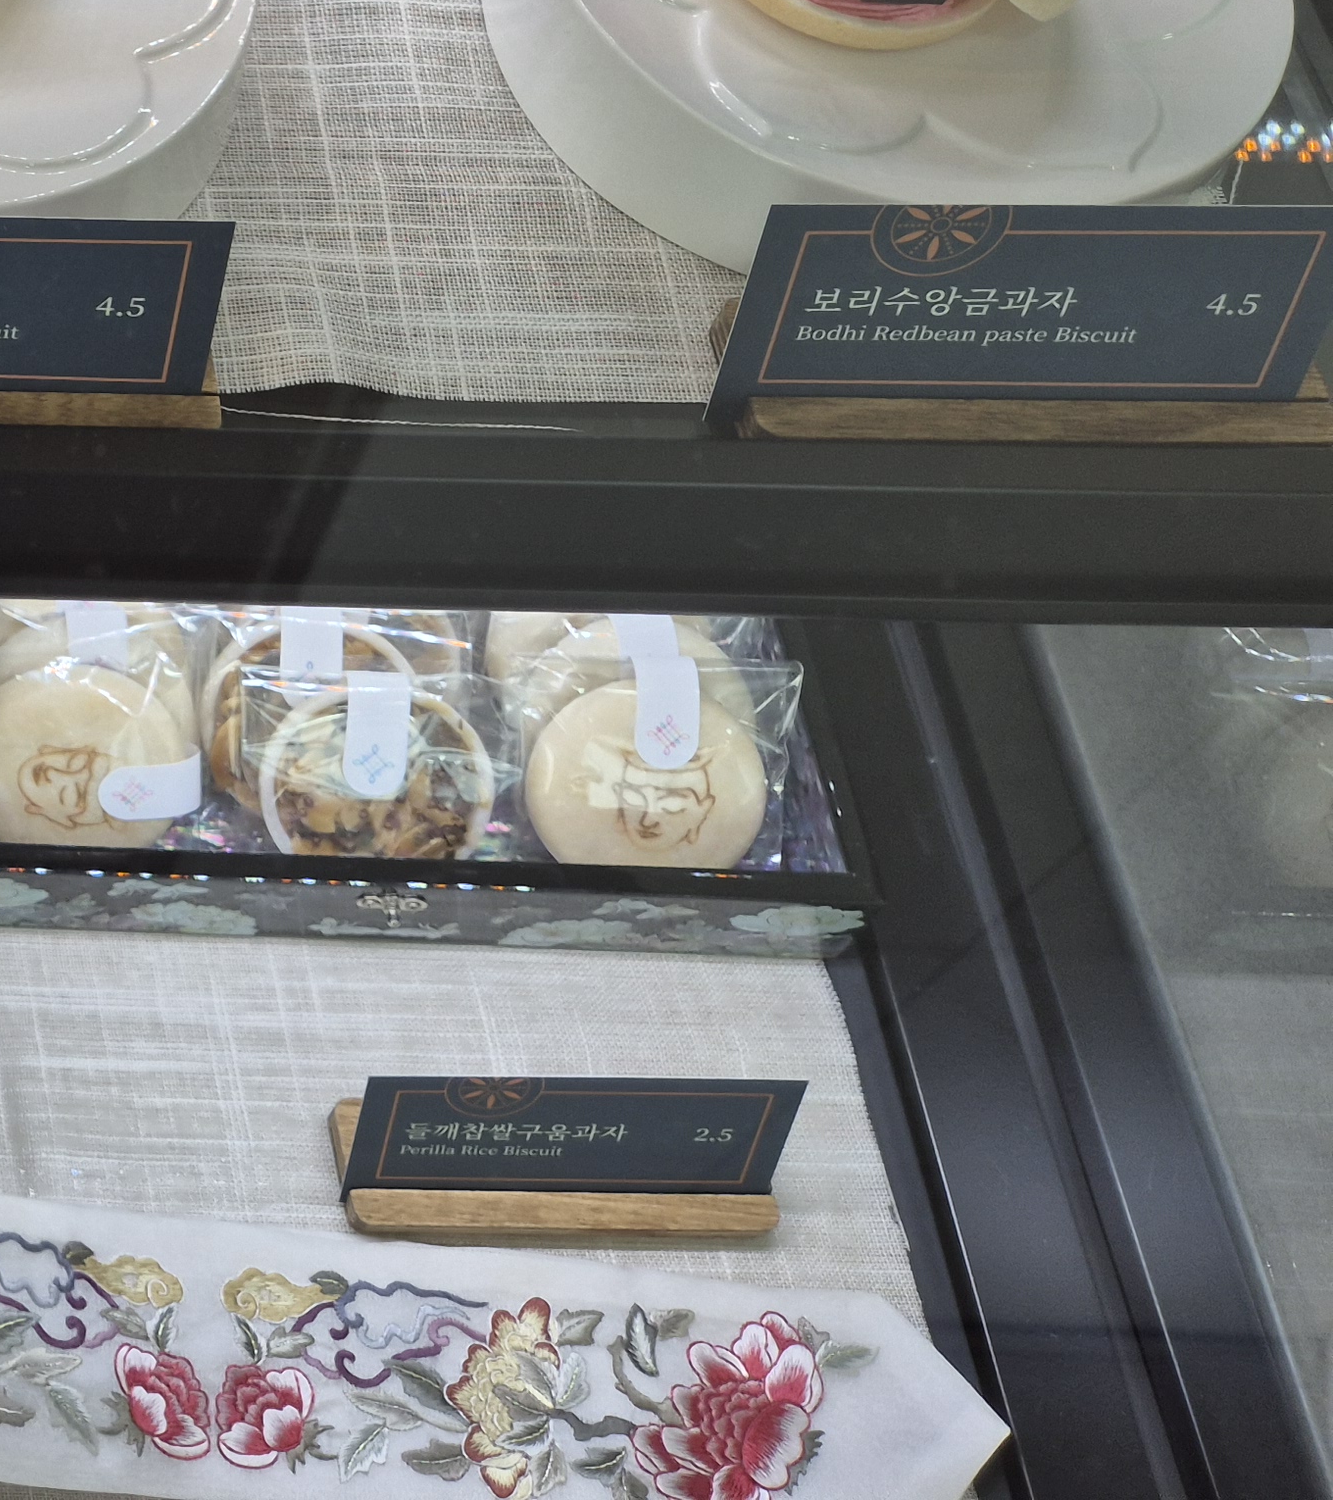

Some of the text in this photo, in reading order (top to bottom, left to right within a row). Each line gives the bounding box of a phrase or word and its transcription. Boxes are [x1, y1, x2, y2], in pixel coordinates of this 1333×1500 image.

[95, 297, 146, 318] 4.5
[804, 286, 1078, 317] 보리수앙금과자
[1205, 293, 1262, 316] 4.5
[795, 324, 1138, 347] Bodhi Redbean paste Biscuit
[405, 1122, 629, 1143] 들깨찹쌀구움과자
[693, 1127, 734, 1143] 2.5
[399, 1144, 563, 1158] Perilla Rice Biscuit
